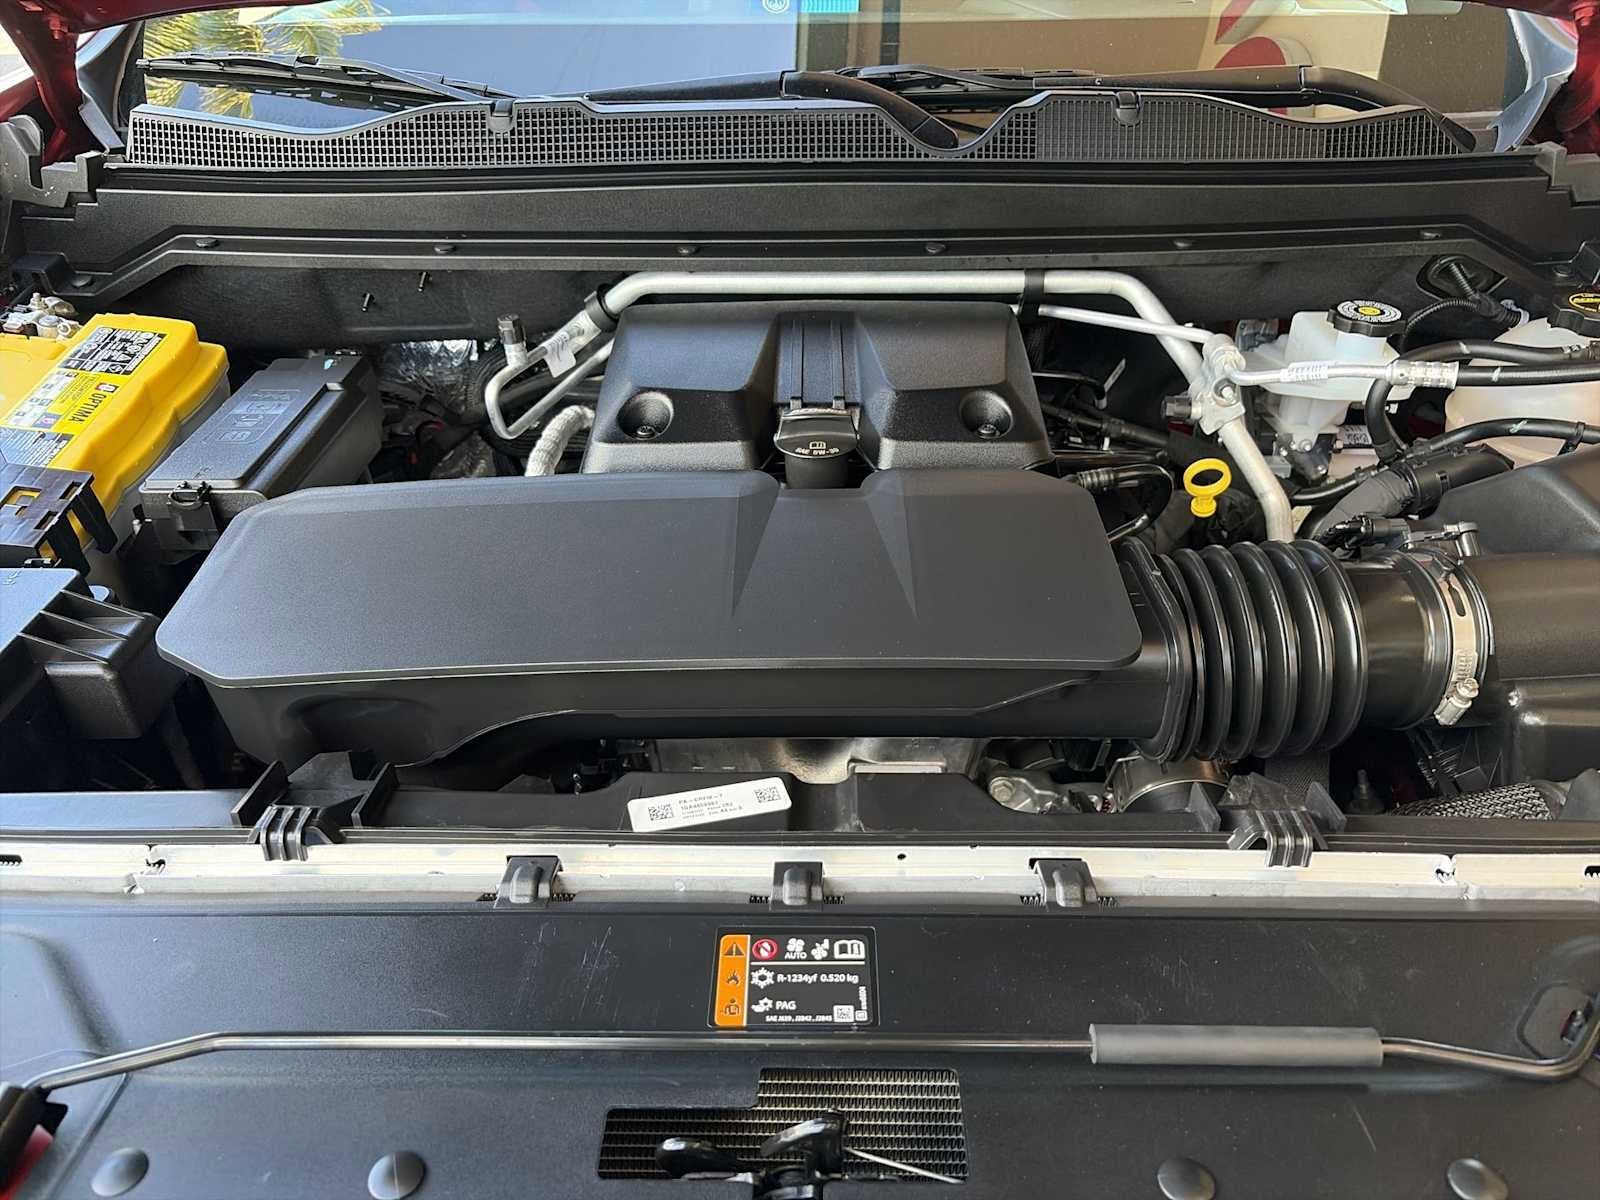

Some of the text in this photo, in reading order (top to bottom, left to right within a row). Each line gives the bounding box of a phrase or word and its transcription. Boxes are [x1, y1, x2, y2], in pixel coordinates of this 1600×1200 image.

[68, 393, 107, 422] OPTIMA
[784, 951, 807, 960] AUTO
[777, 973, 859, 984] R-1234yf 0.520 kg
[775, 1000, 797, 1010] PAG
